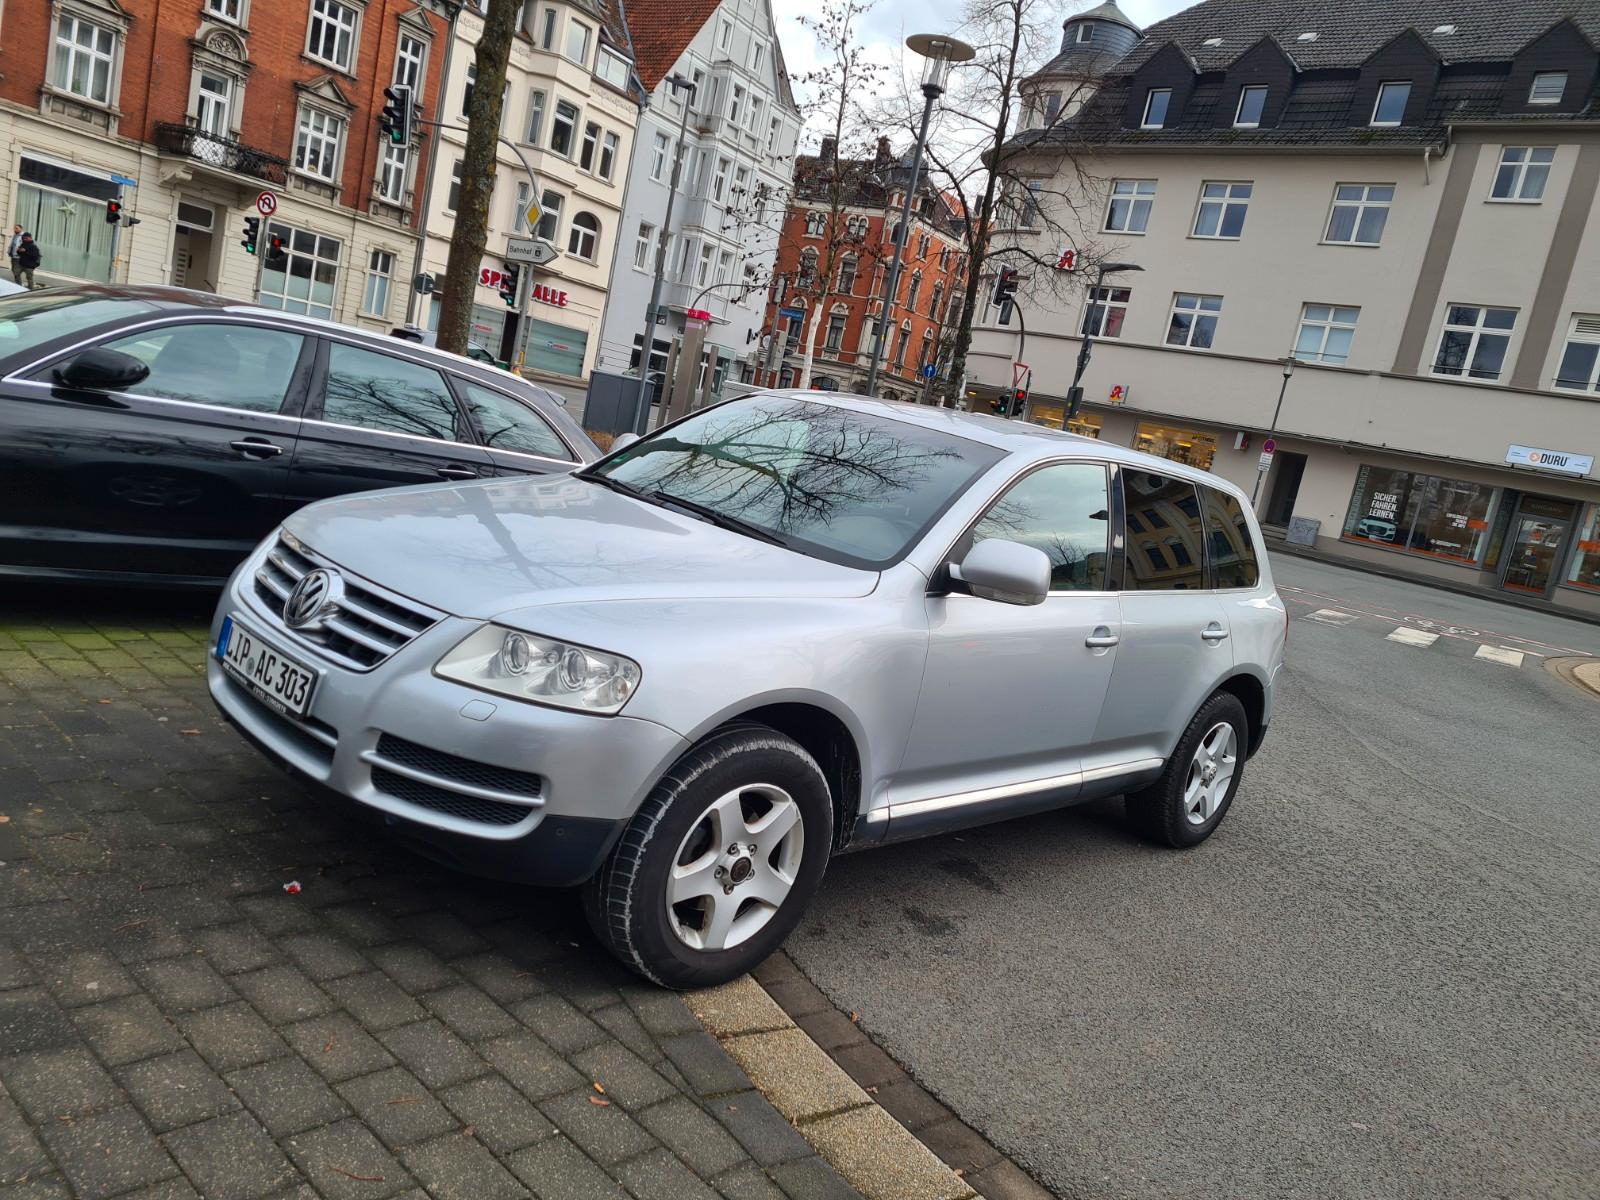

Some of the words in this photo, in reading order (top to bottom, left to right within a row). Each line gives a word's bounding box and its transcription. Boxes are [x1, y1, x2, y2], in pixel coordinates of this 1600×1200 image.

[509, 245, 533, 255] Bahnhof
[1540, 453, 1568, 467] DURU
[1373, 491, 1398, 504] SICHER.
[1371, 500, 1398, 512] FAHREN.
[1368, 507, 1395, 520] LERNEN.
[254, 649, 277, 686] AC
[275, 661, 310, 706] 303
